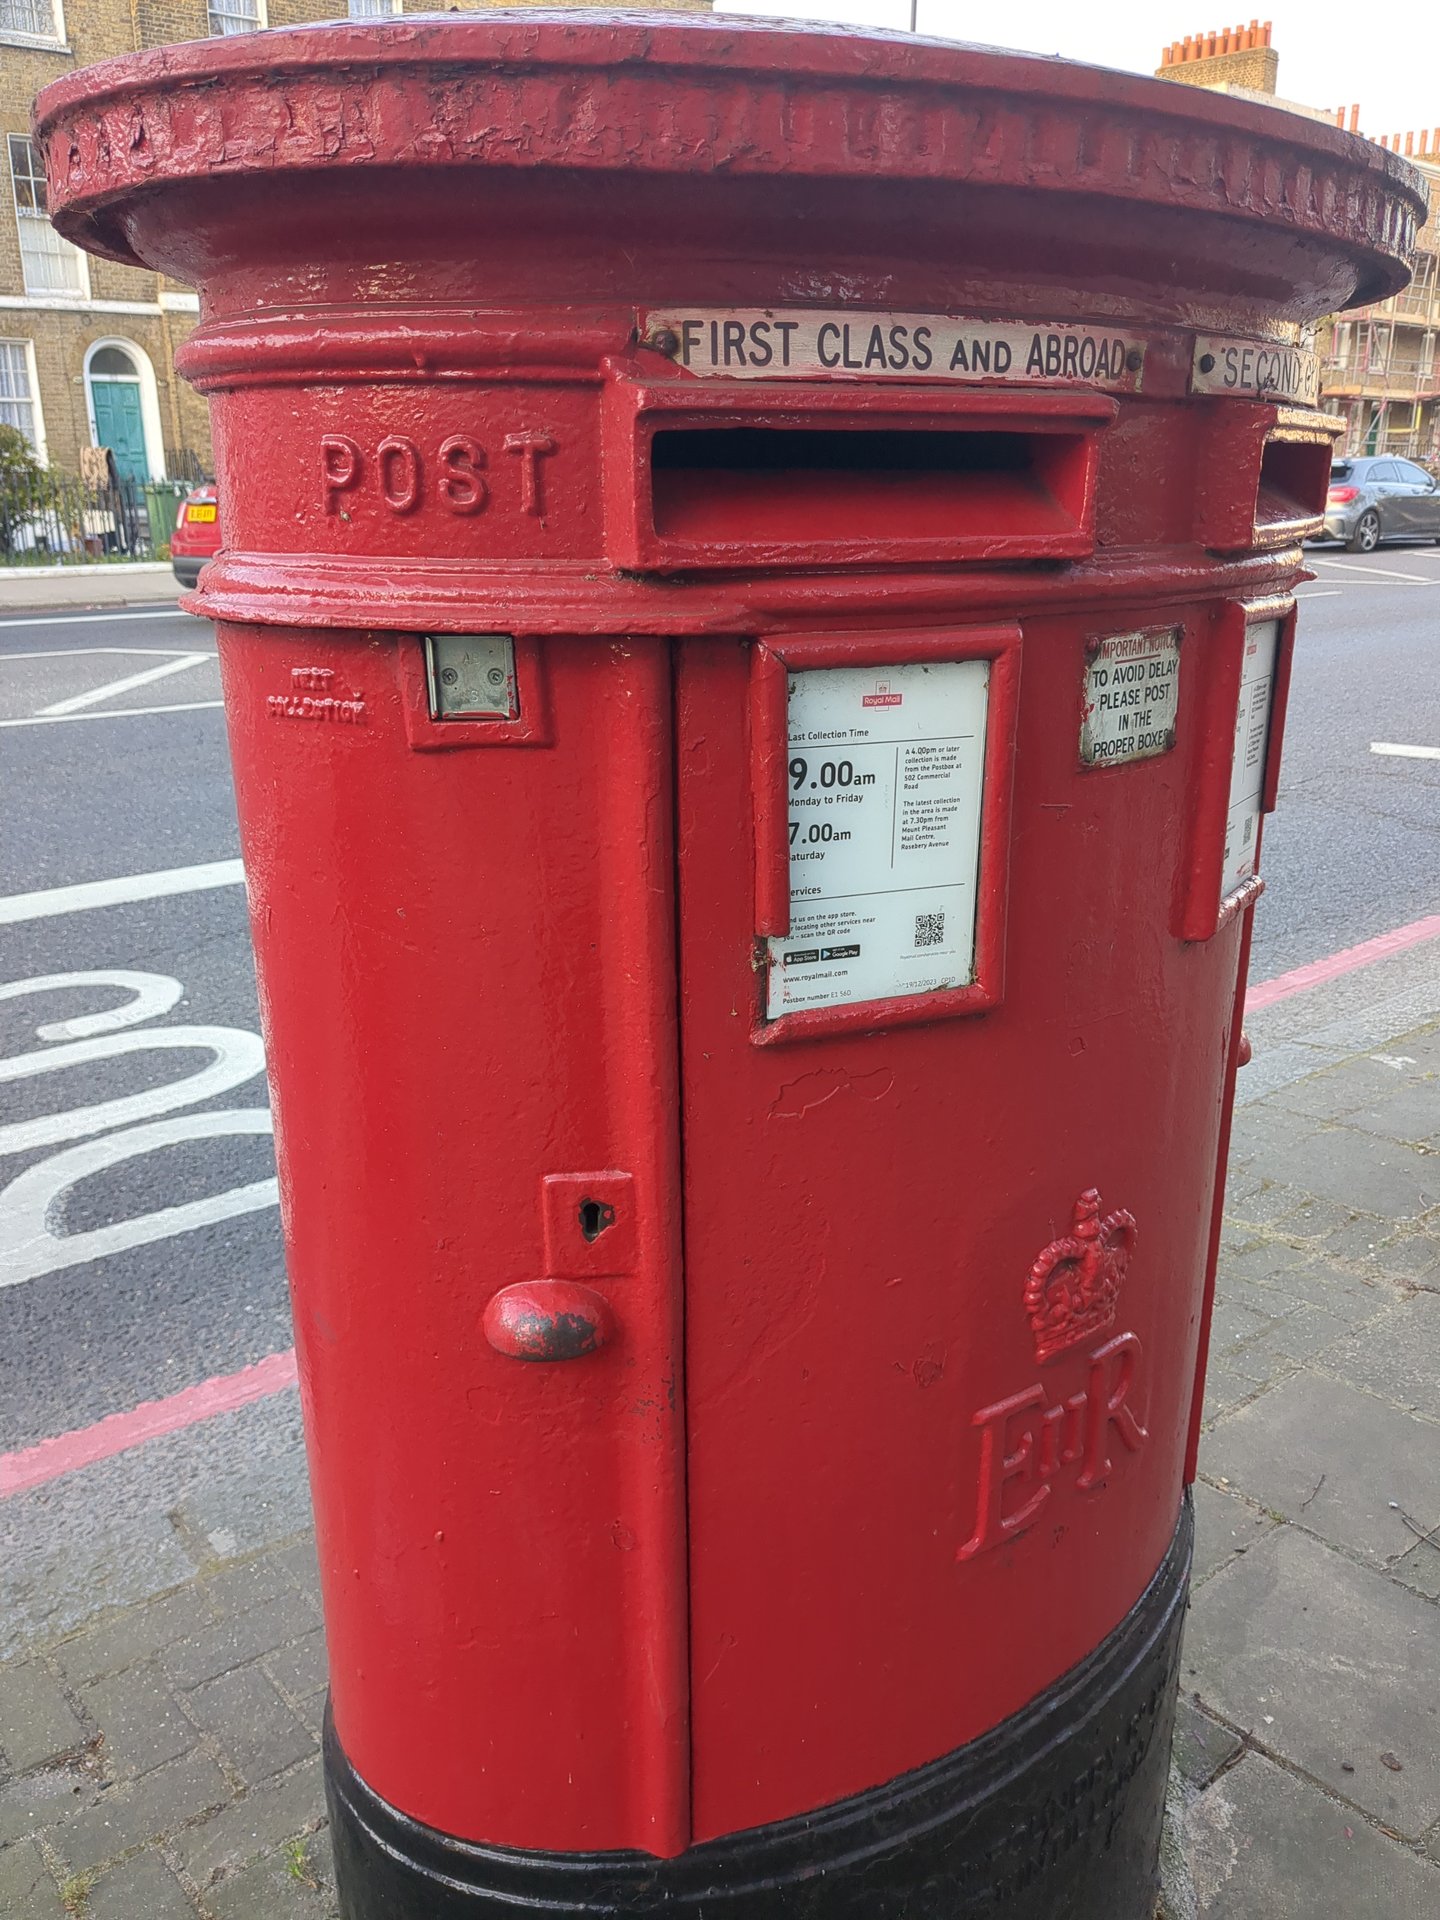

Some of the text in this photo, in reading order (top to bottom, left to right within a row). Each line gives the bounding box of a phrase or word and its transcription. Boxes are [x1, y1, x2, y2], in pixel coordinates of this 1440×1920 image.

[682, 320, 1126, 381] FIRST CLASS AND ABROAD
[1223, 347, 1301, 394] SECOND
[321, 433, 560, 516] POST
[1099, 638, 1146, 660] IMPORTANT
[1092, 659, 1178, 688] TO AVOID DELAY
[864, 694, 900, 706] Royal Mail
[1099, 683, 1170, 711] PLEASE POST
[1118, 710, 1152, 732] IN THE
[788, 728, 870, 742] Last Collection Time
[1092, 736, 1135, 760] PROPER
[788, 758, 876, 790] 9.00am
[917, 772, 950, 780] Commercial
[788, 794, 864, 807] Monday to Friday
[910, 817, 933, 825] 7.30pm
[788, 822, 851, 845] 7.00am
[789, 850, 825, 861] aturday
[790, 886, 822, 896] ervices
[795, 923, 819, 931] locating
[783, 970, 848, 983] www.royalmail.com
